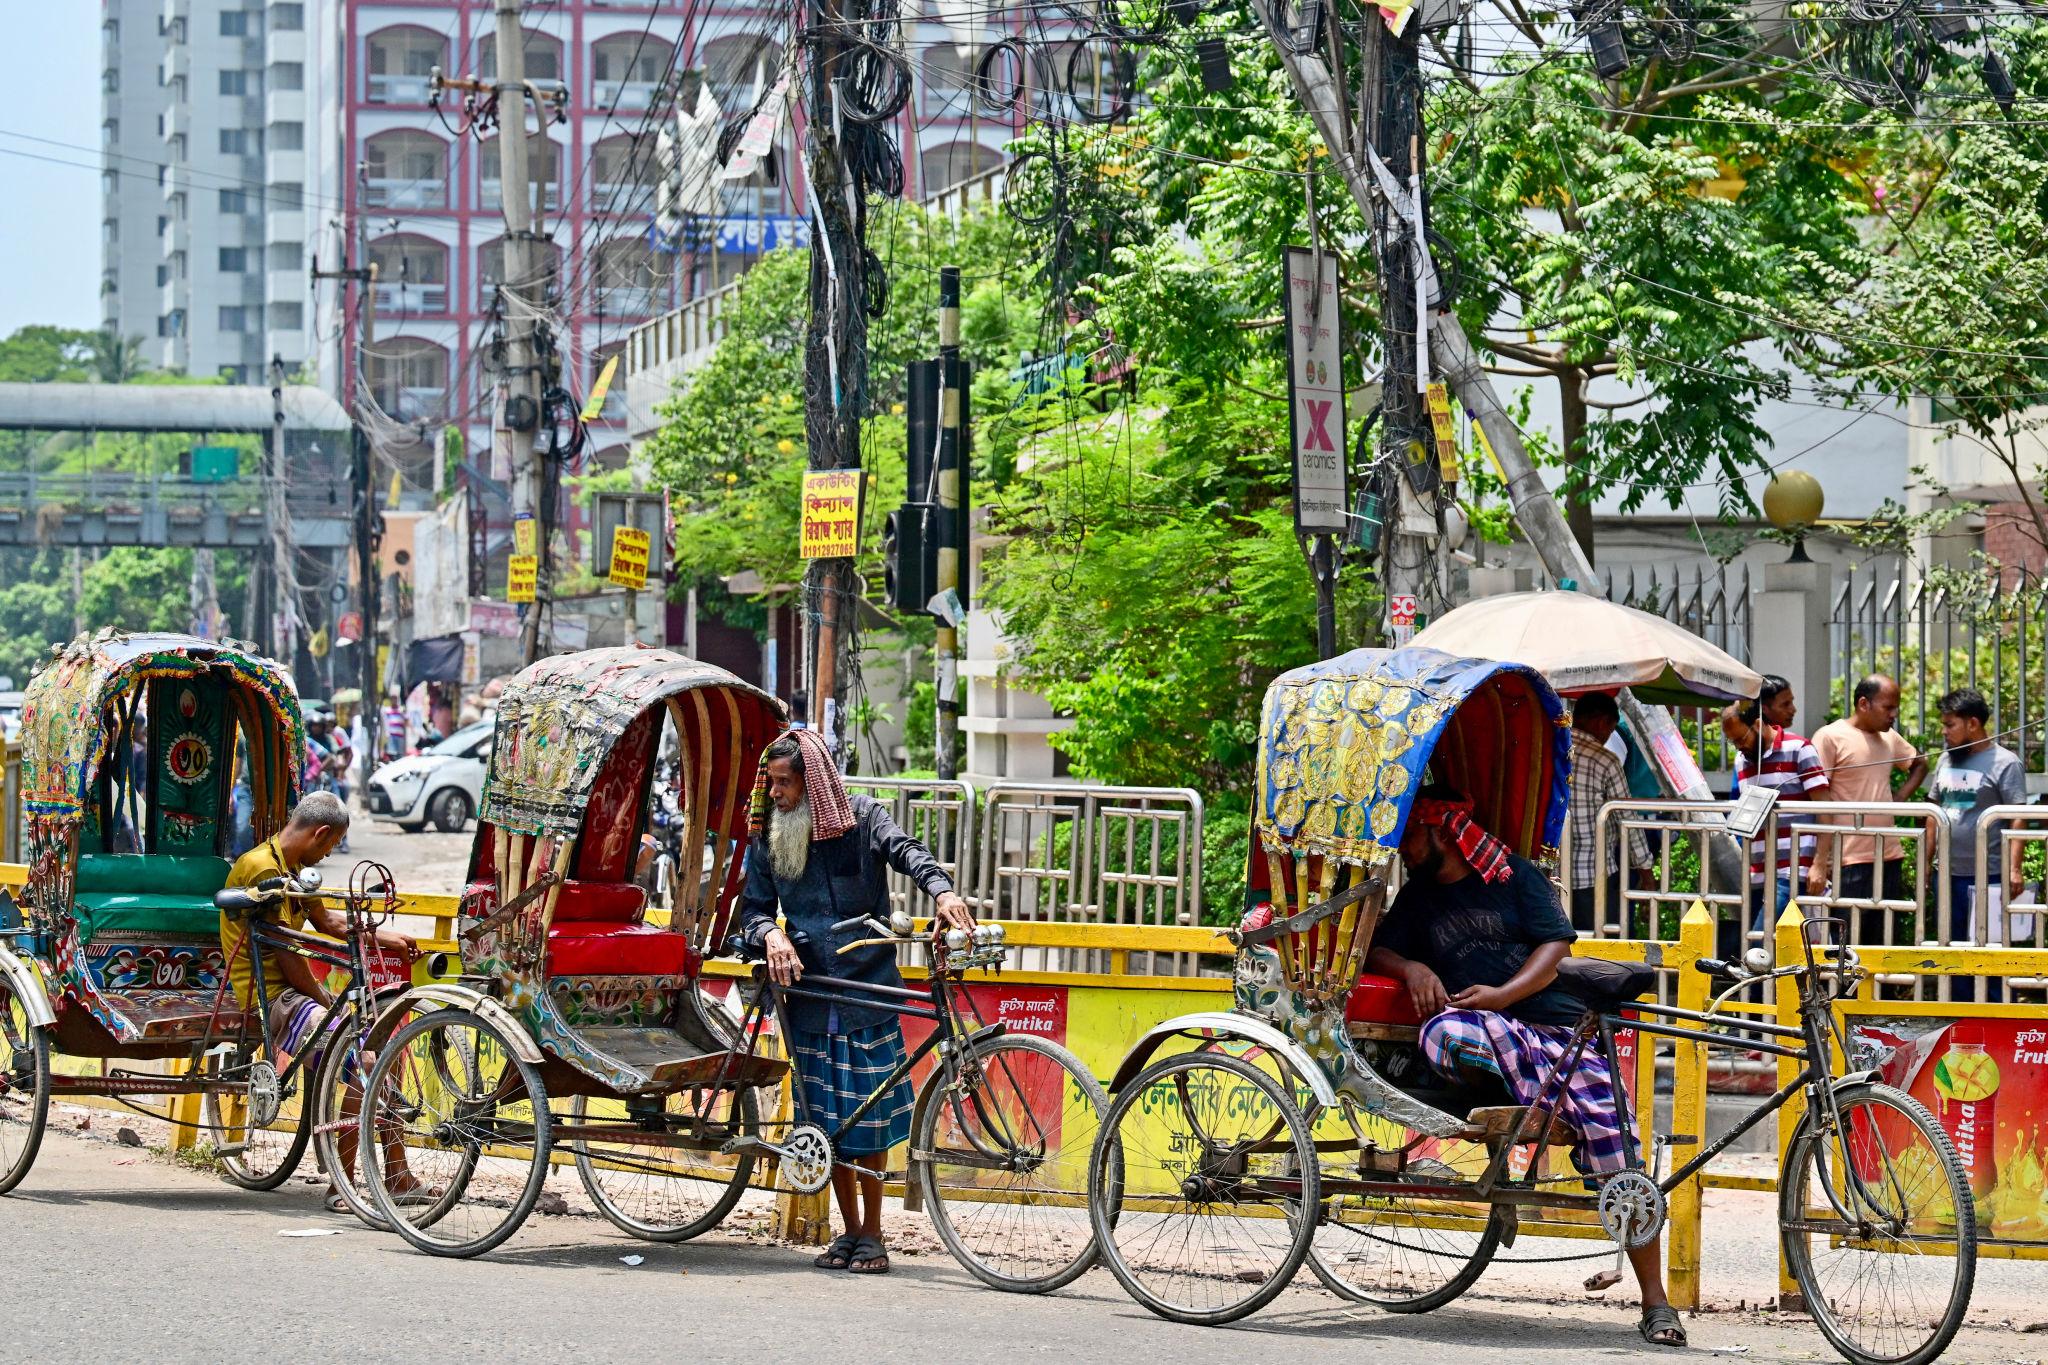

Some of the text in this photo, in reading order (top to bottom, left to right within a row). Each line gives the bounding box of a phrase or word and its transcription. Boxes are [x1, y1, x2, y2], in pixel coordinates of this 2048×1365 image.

[1303, 454, 1336, 470] ceramics
[803, 543, 854, 557] 01912927065
[1564, 663, 1618, 675] banglalink
[1701, 667, 1734, 684] banglalink
[1026, 998, 1056, 1013] মানেই
